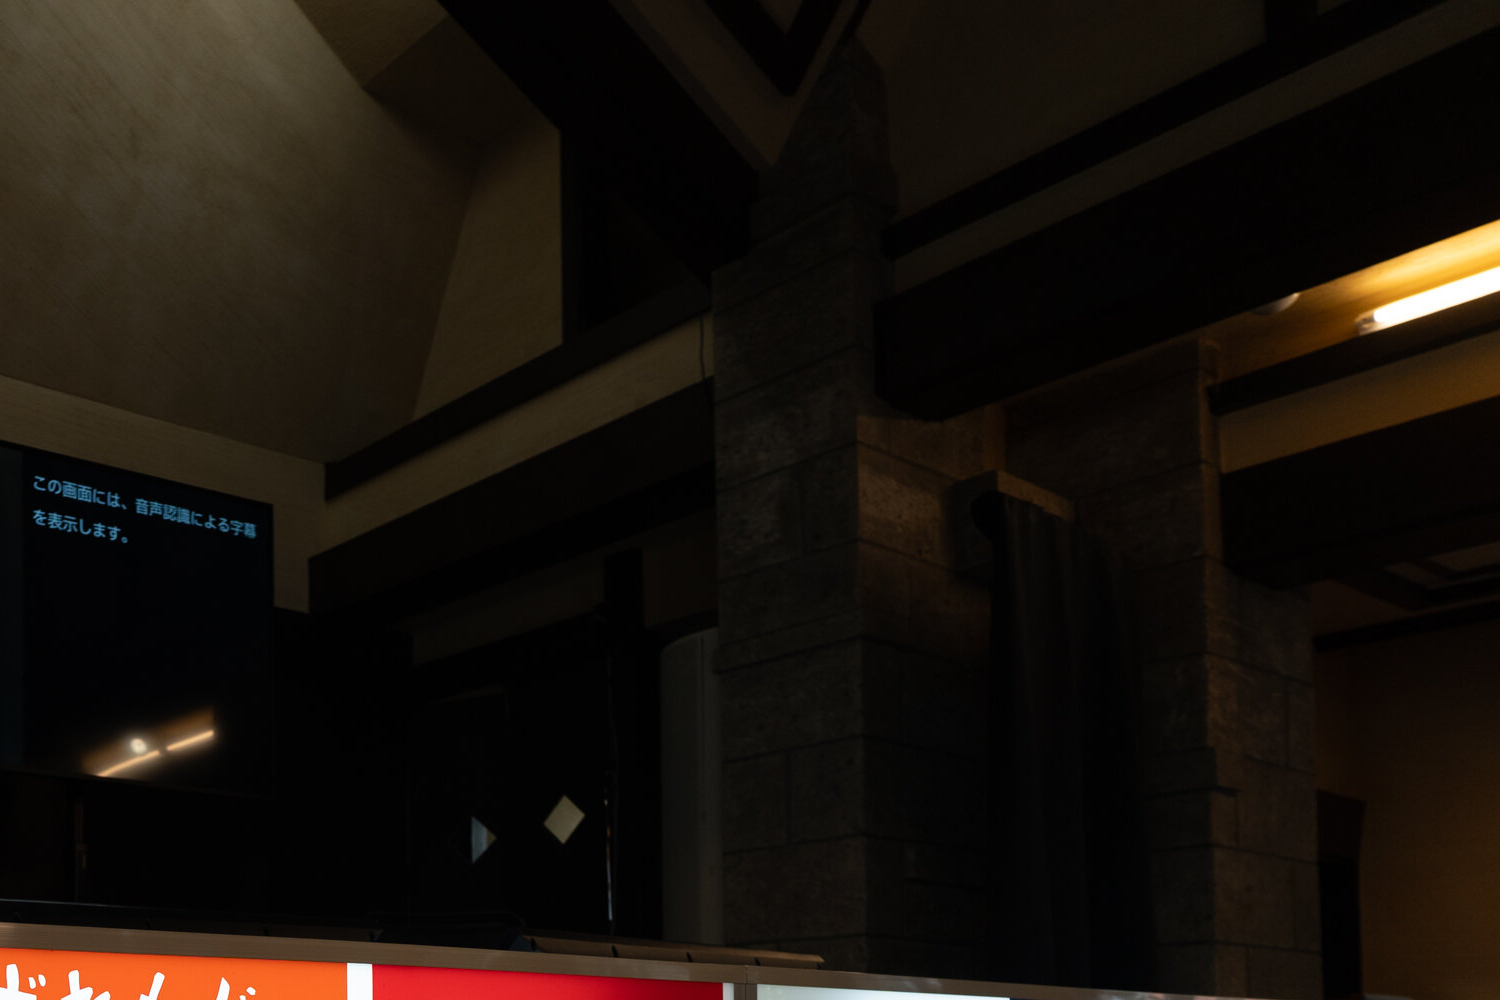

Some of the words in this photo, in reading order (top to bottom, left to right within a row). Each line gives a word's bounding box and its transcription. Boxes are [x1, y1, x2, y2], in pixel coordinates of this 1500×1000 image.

[32, 509, 129, 544] を表示します。
[33, 475, 257, 538] この画面には、音声認識による字幕
